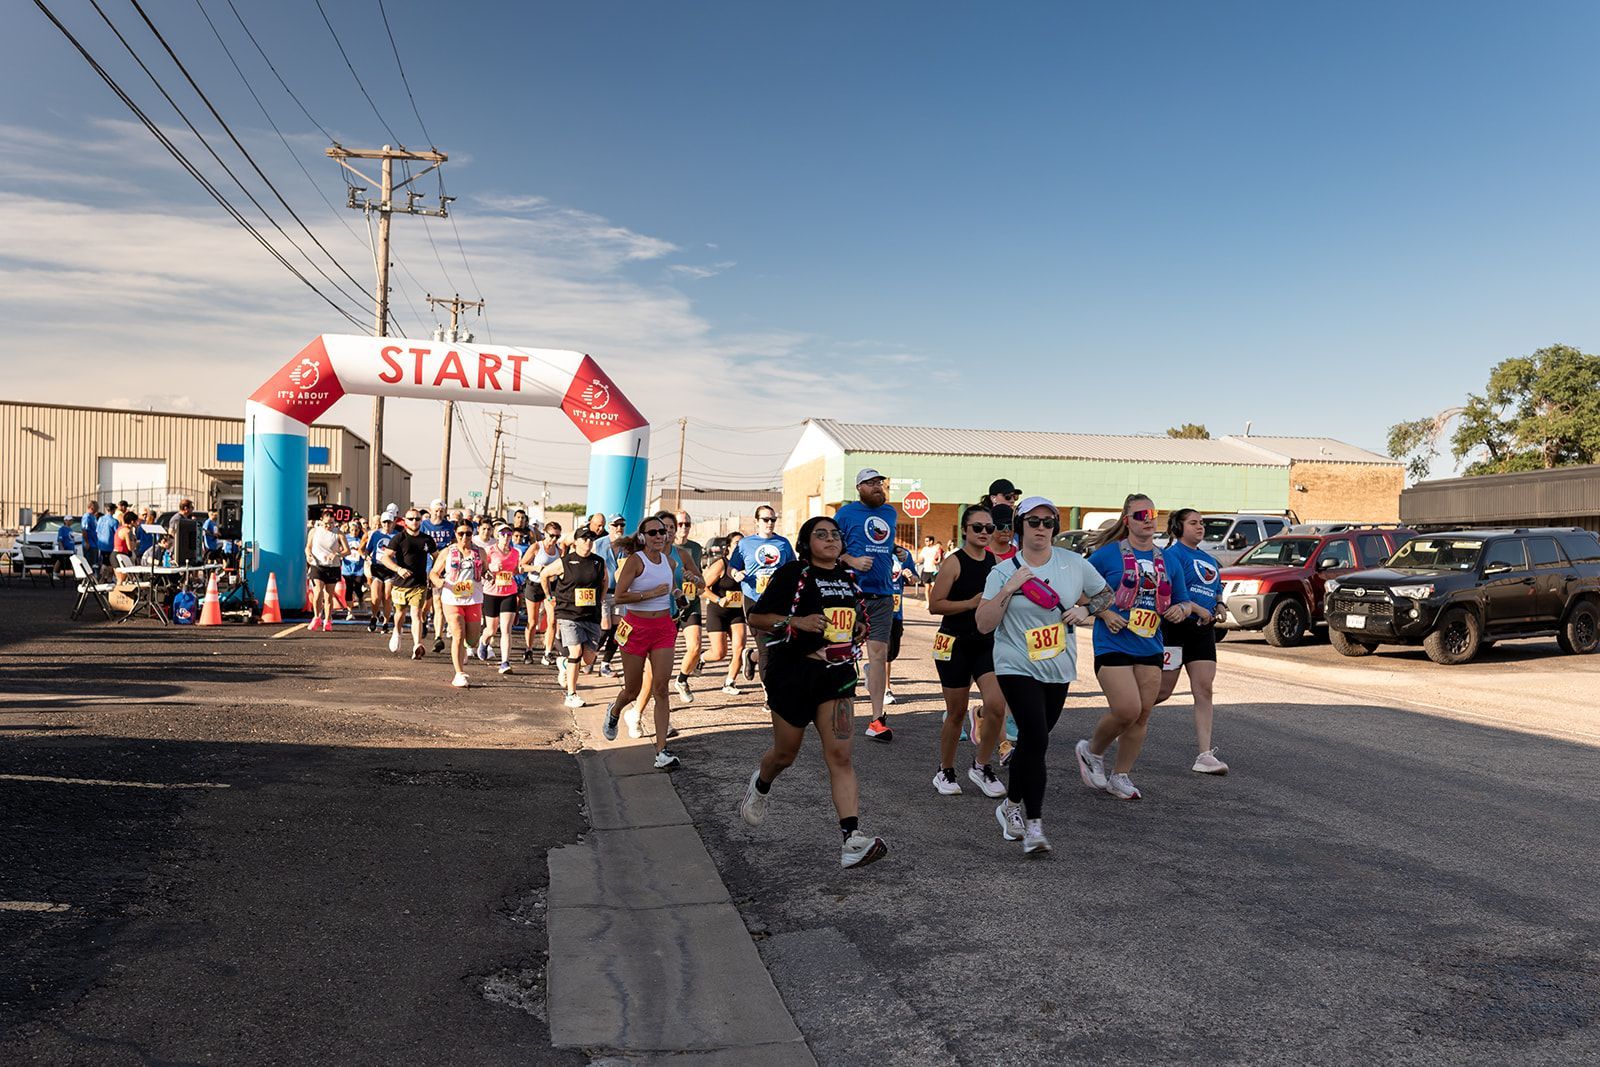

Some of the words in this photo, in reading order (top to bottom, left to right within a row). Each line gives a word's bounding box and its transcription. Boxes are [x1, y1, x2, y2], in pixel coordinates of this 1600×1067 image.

[378, 345, 529, 392] START
[277, 390, 294, 399] IT'S
[297, 391, 329, 399] ABOUT
[572, 409, 587, 418] IT'S
[589, 411, 619, 421] ABOUT
[904, 498, 928, 510] STOP
[579, 589, 594, 600] 365
[831, 610, 853, 630] 403
[1133, 610, 1158, 629] 370
[1031, 626, 1060, 649] 387
